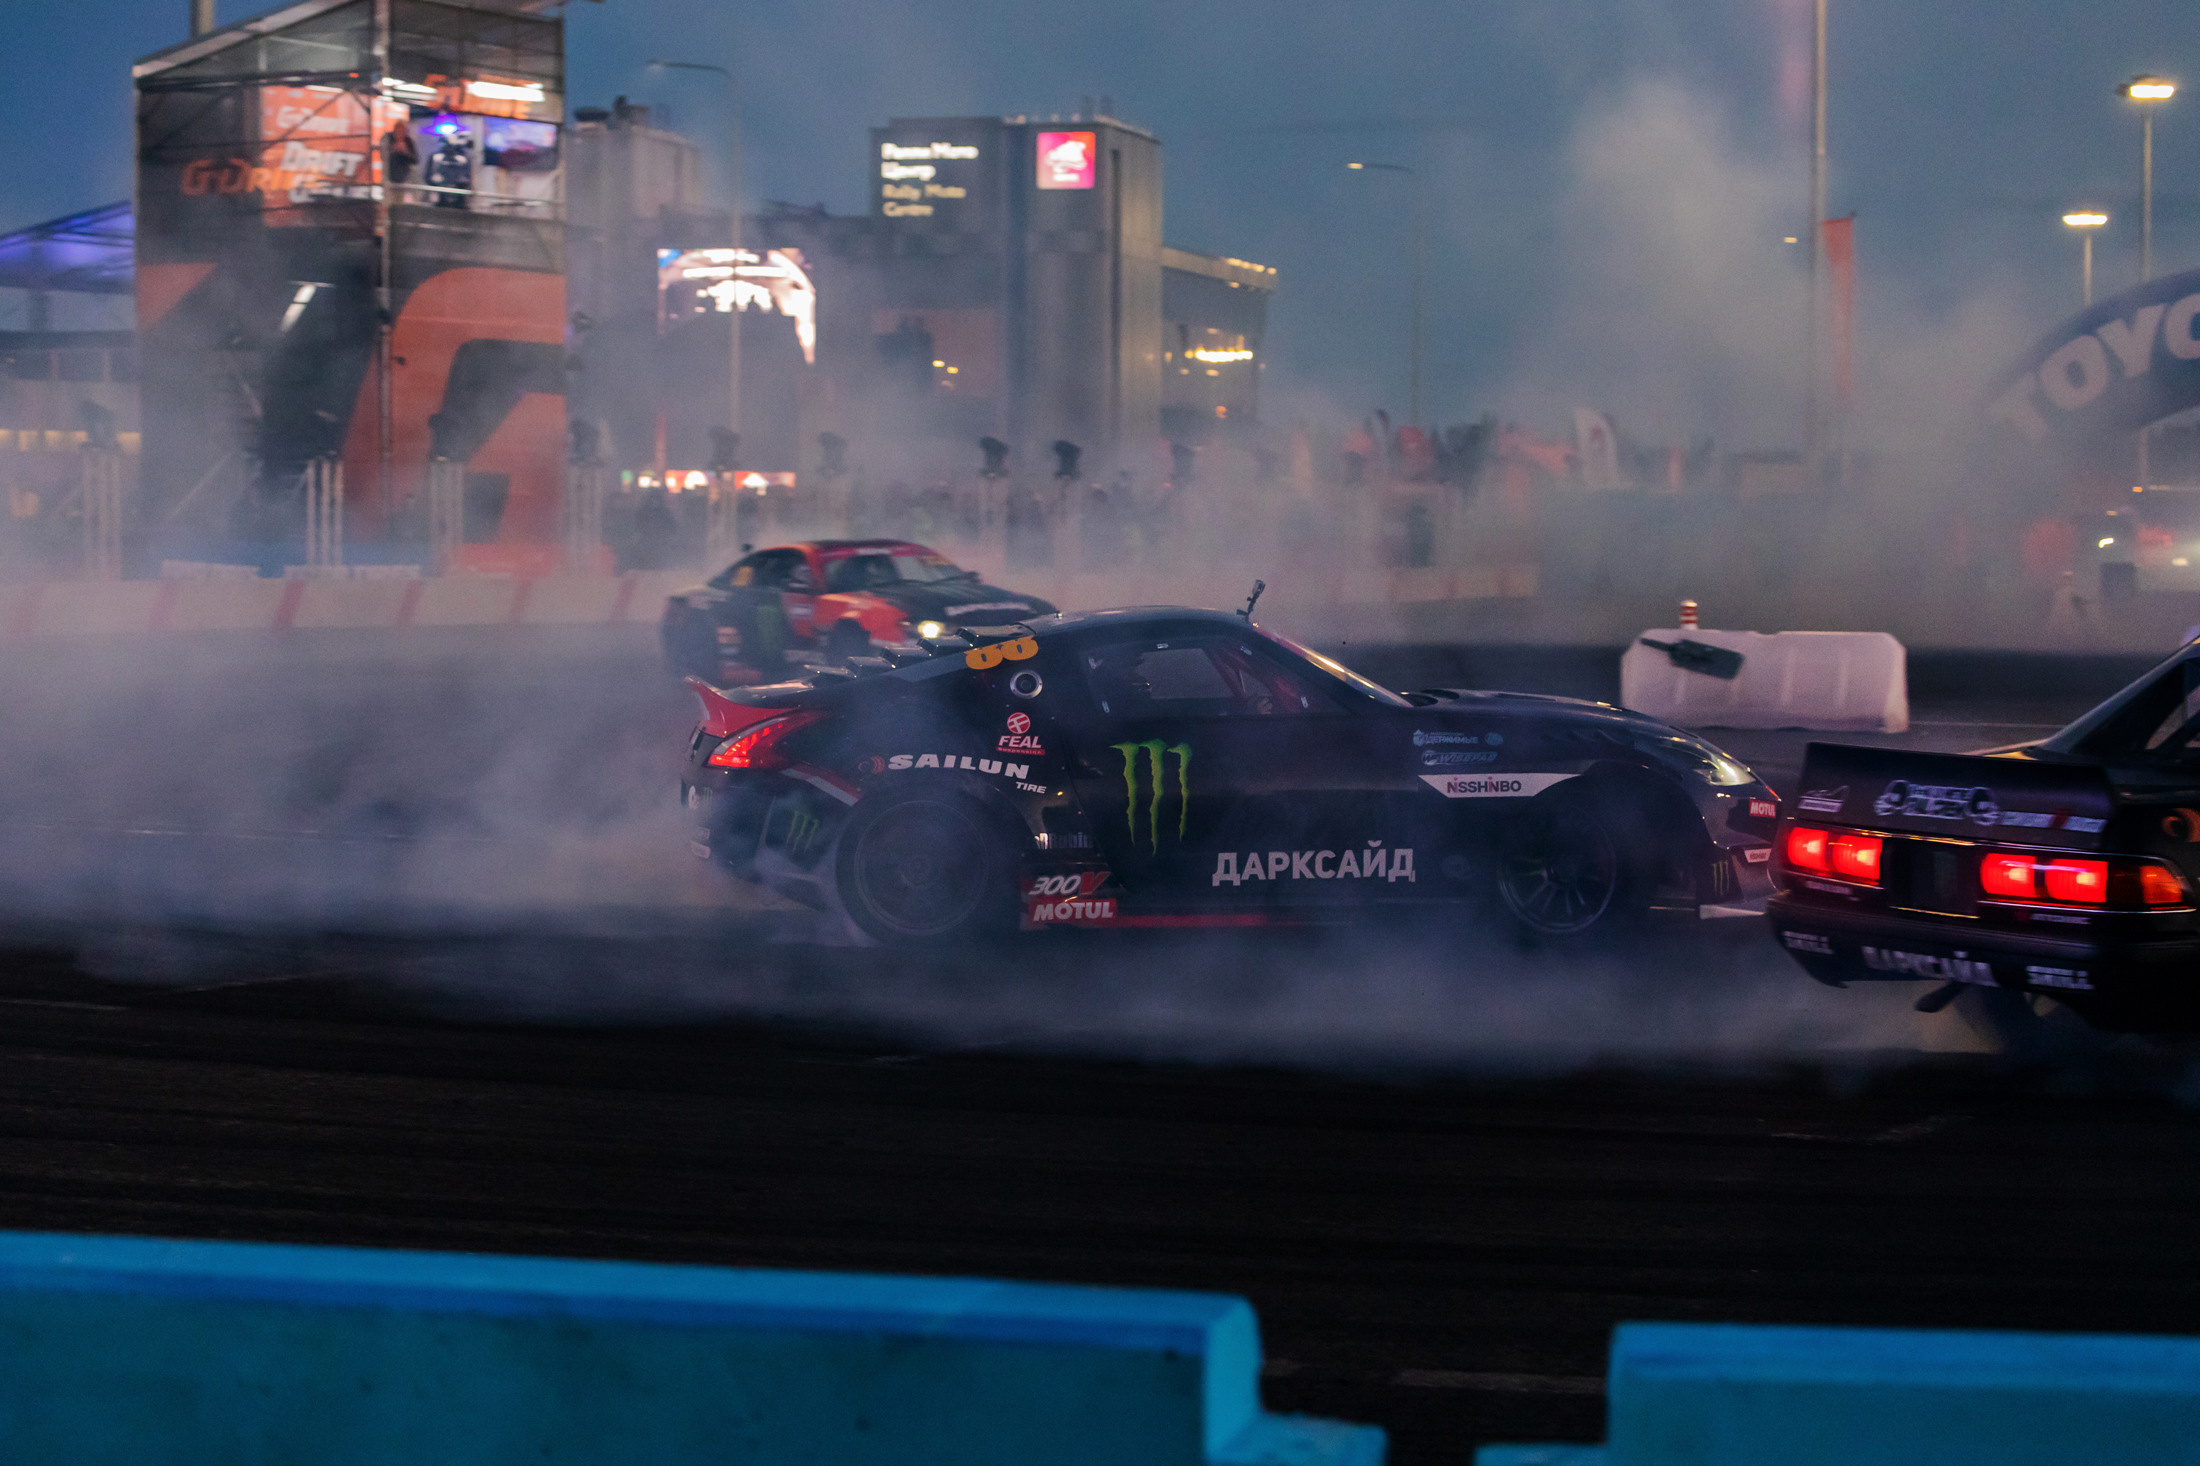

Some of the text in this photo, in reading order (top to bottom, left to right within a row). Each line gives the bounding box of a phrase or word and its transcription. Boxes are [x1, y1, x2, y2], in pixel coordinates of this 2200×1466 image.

[998, 736, 1042, 749] FEAL
[888, 753, 1030, 780] SAILUN
[1015, 781, 1048, 795] TIRE
[1750, 801, 1776, 817] MOTUL
[1212, 840, 1416, 887] ДАРКСАЙД
[1033, 901, 1114, 921] MOTUL
